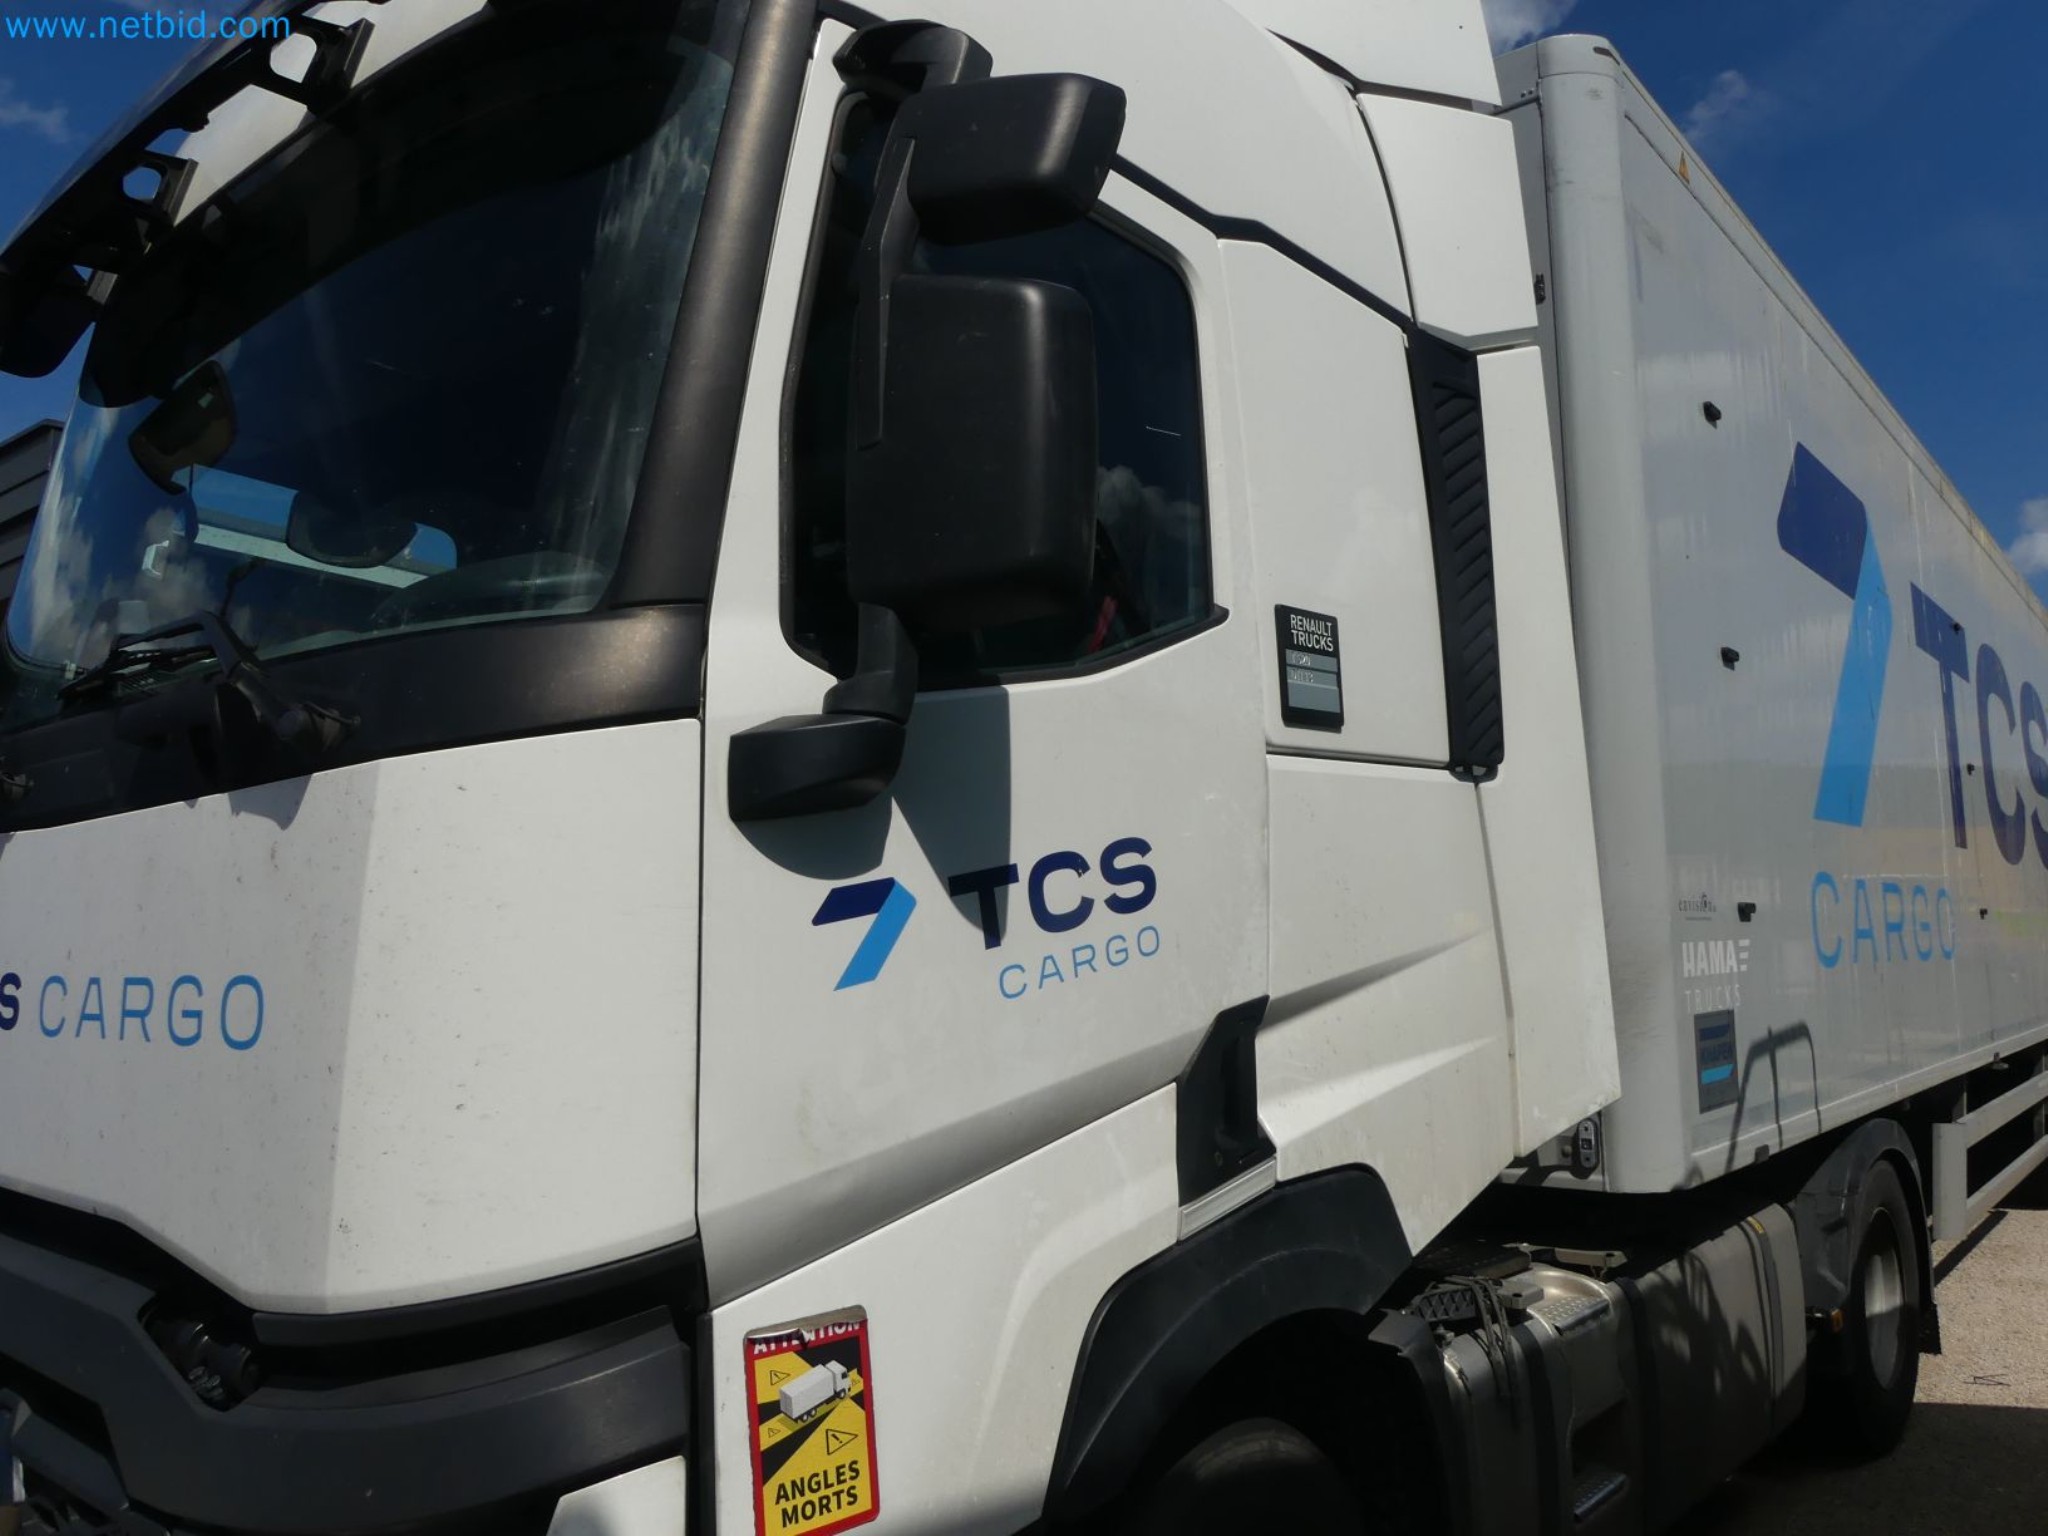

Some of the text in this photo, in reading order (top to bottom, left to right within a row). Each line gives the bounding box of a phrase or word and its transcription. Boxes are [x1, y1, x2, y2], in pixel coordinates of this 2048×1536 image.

[1290, 614, 1332, 636] RENAULT
[1291, 630, 1334, 652] TRUCKS
[947, 836, 1157, 951] TCS
[1811, 871, 1957, 968] CARGO
[998, 925, 1161, 999] CARGO
[38, 974, 265, 1051] CARGO
[1684, 984, 1740, 1014] TRUCKS
[775, 1460, 860, 1506] ANGLES
[782, 1486, 858, 1529] MORTS
